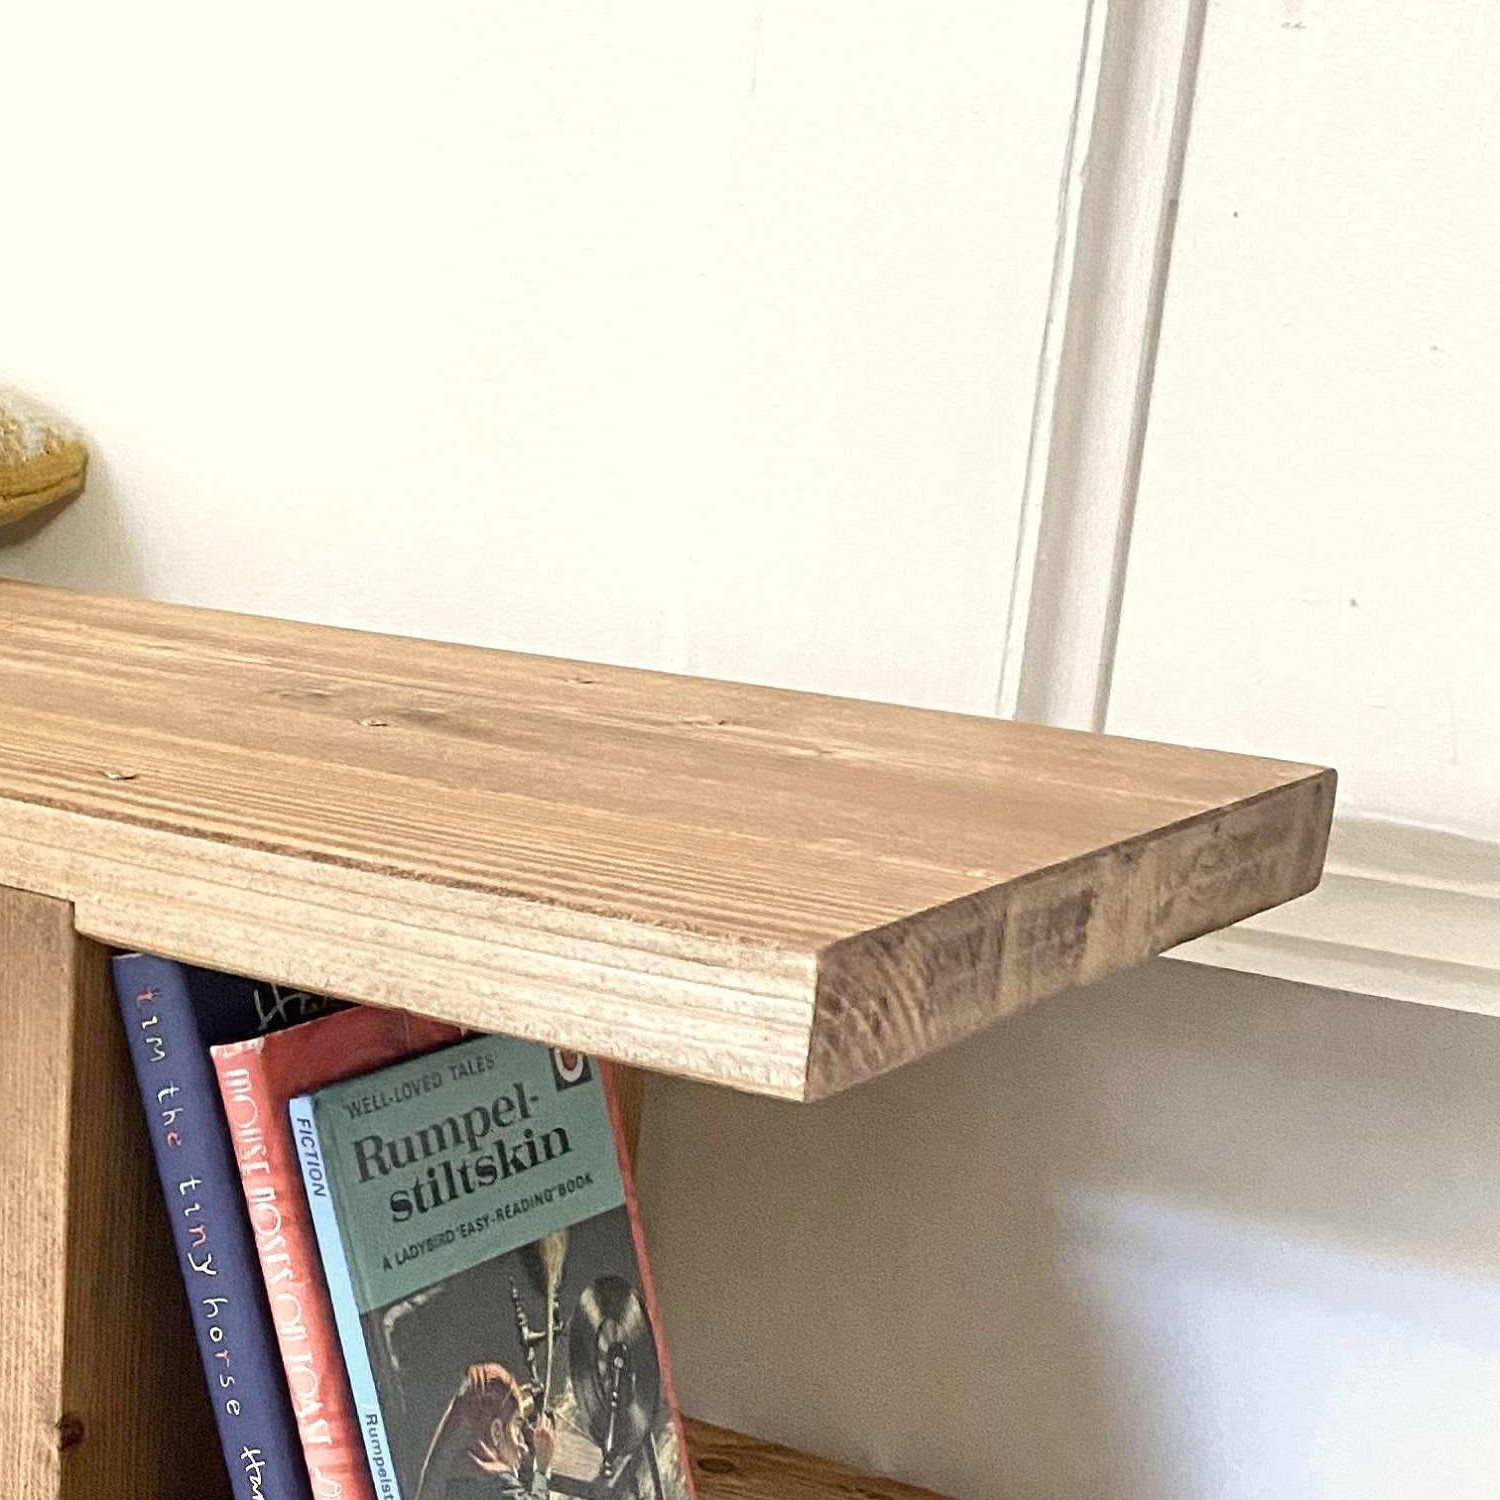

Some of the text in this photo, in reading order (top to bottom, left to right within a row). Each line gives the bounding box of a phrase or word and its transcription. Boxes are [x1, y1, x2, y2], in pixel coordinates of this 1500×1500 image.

[297, 1117, 326, 1198] FICTION
[352, 1081, 540, 1184] Rumpel-
[389, 1127, 574, 1223] stiltskin
[136, 986, 241, 1416] tim the tiny horse
[382, 1255, 393, 1272] A
[395, 1229, 455, 1267] LADYBIRD
[557, 1172, 594, 1198] BOOK
[222, 1068, 333, 1446] MOUSE NOSES ON TOAST
